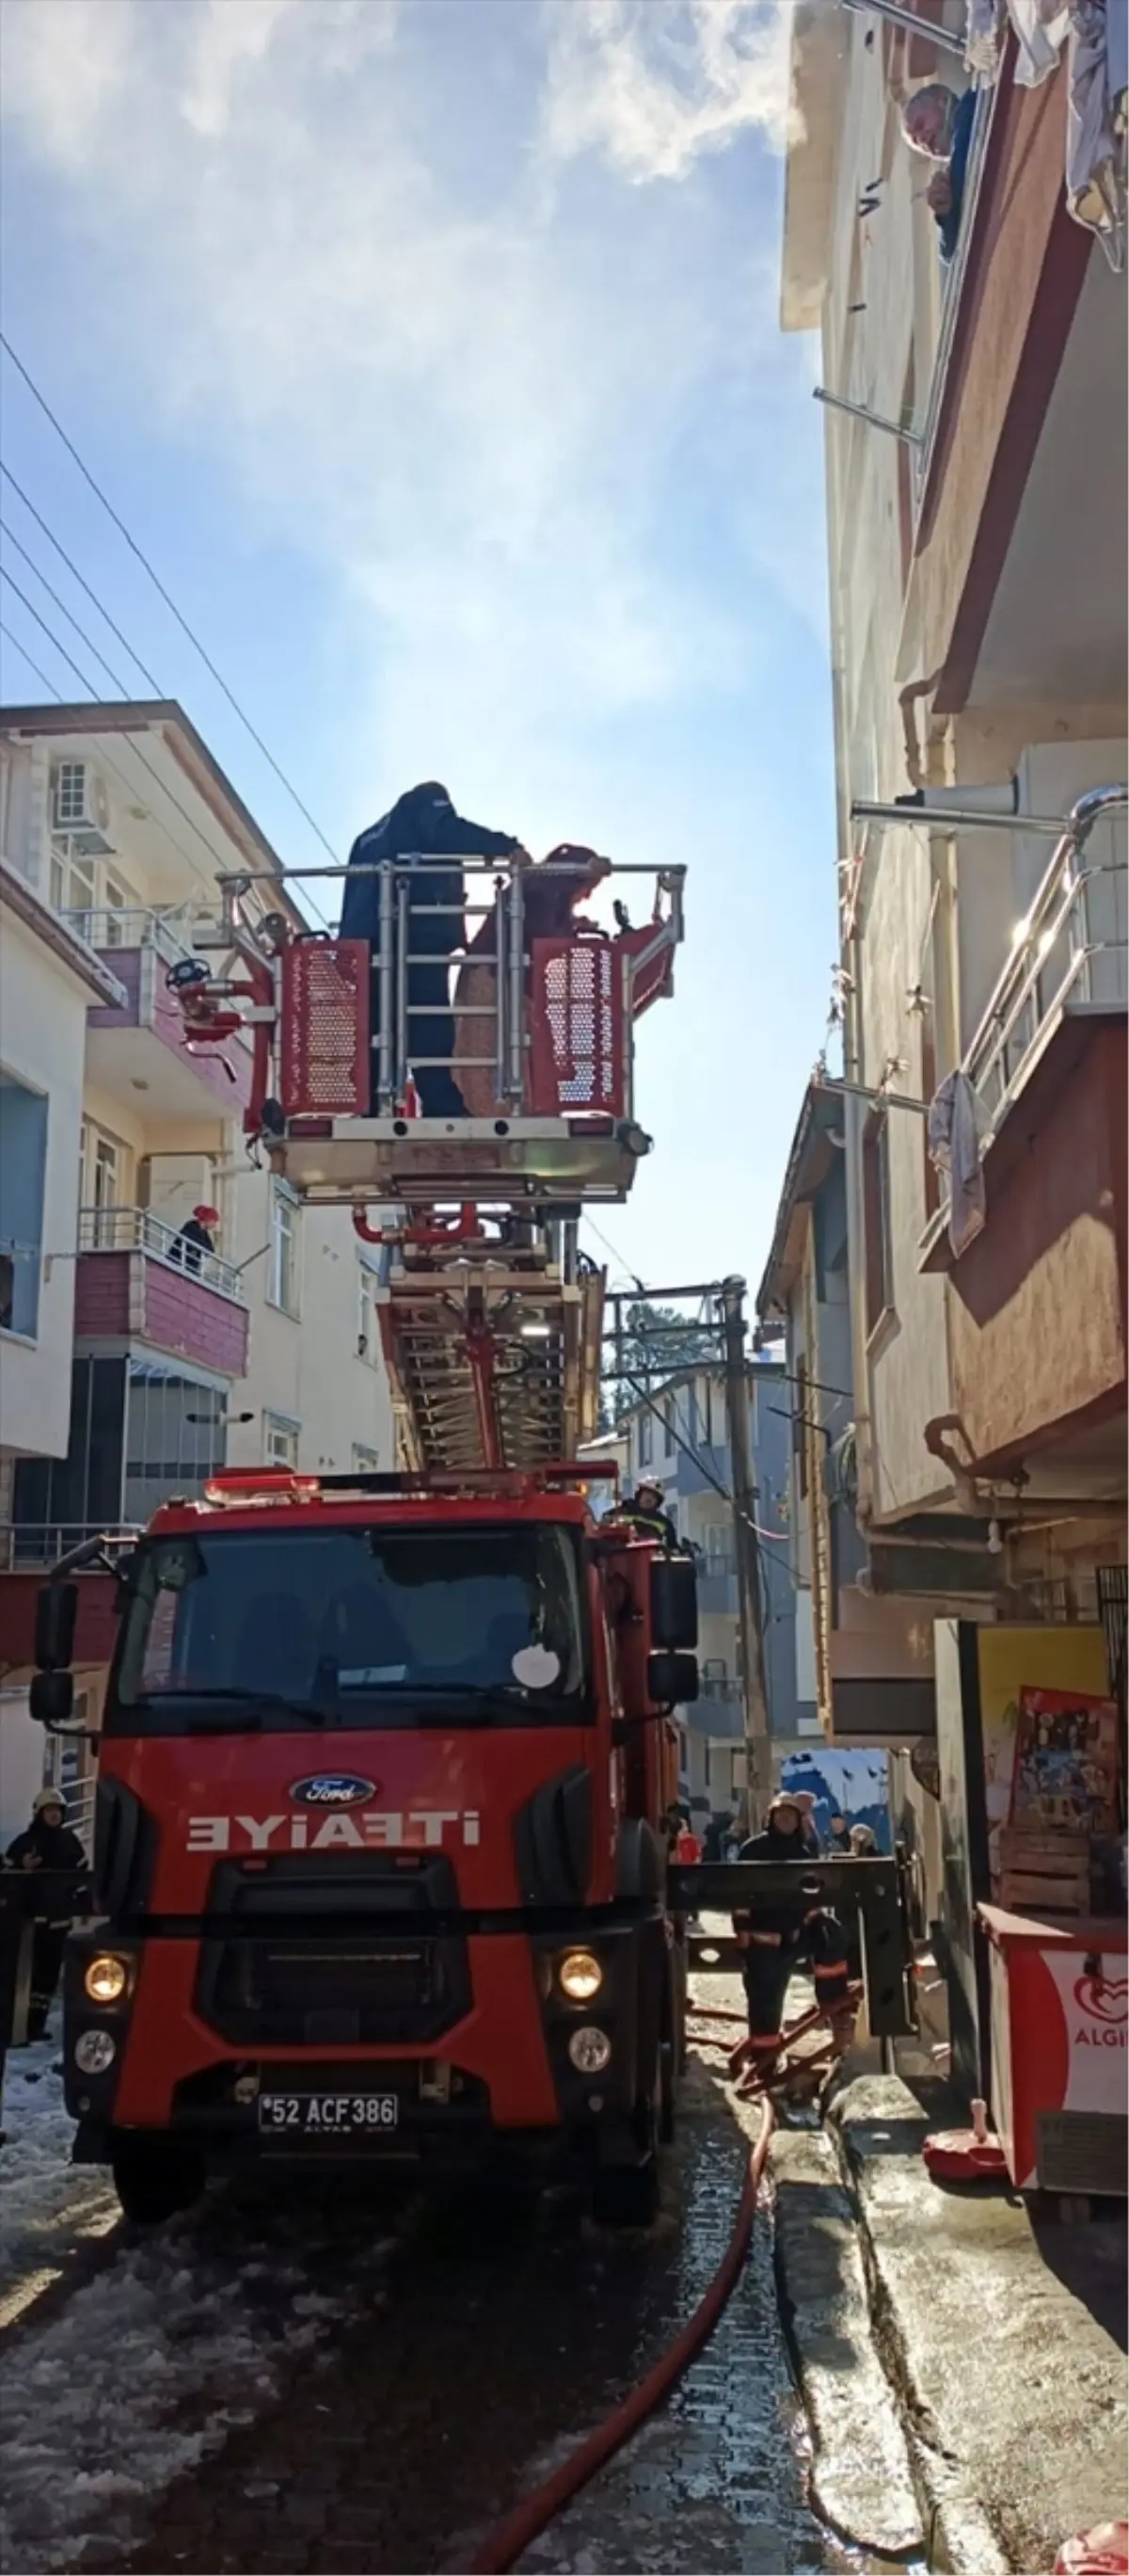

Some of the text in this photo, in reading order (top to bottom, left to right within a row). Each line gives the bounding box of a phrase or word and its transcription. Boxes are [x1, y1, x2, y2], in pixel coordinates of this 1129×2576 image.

[306, 1780, 357, 1801] Ford
[1074, 2027, 1129, 2048] ALGI
[272, 2098, 393, 2124] 52 ACF 386
